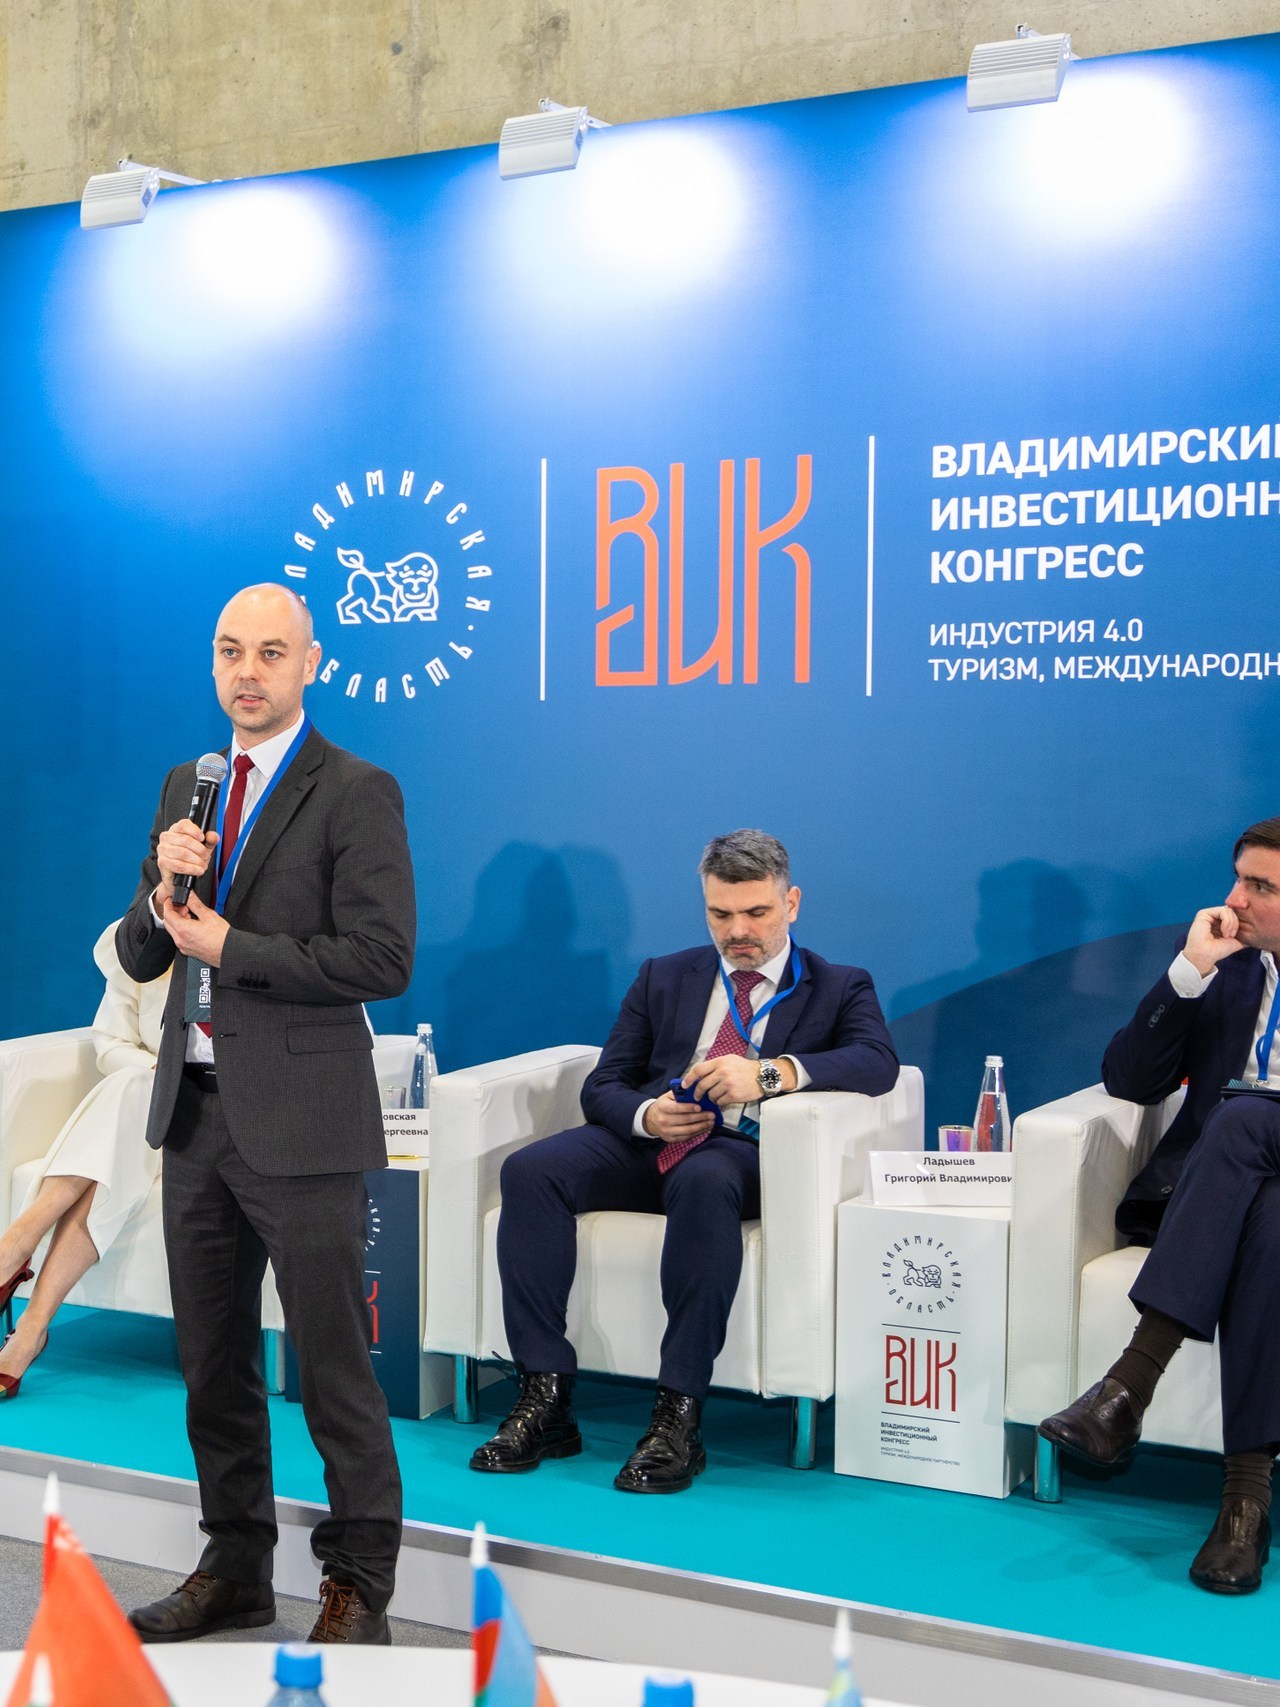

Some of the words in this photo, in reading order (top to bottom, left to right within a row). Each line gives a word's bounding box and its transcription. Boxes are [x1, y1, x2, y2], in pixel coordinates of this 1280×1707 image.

[931, 423, 1280, 479] ВЛАДИМИРСКИ
[283, 469, 493, 612] ЛАДИМИРСКАЯ
[595, 454, 812, 687] ВИК
[930, 542, 1145, 584] КОНГРЕСС
[930, 619, 1095, 649] ИНДУСТРИЯ
[1103, 618, 1144, 643] 4.0
[312, 640, 473, 703] БЛАСТЬ
[928, 656, 1046, 683] ТУРИЗМ,
[923, 1157, 976, 1166] Ладышев
[885, 1173, 937, 1184] Григорий
[882, 1235, 962, 1288] ВЛАДИМИРСКАЯ
[888, 1288, 955, 1313] ОБЛАСТЬ
[885, 1335, 957, 1412] ВИК
[880, 1422, 931, 1433] ВЛАДИМИРСКИЙ
[880, 1429, 938, 1442] ИНВЕСТИЦИОННЫЙ
[880, 1437, 911, 1446] КОНГРЕСС
